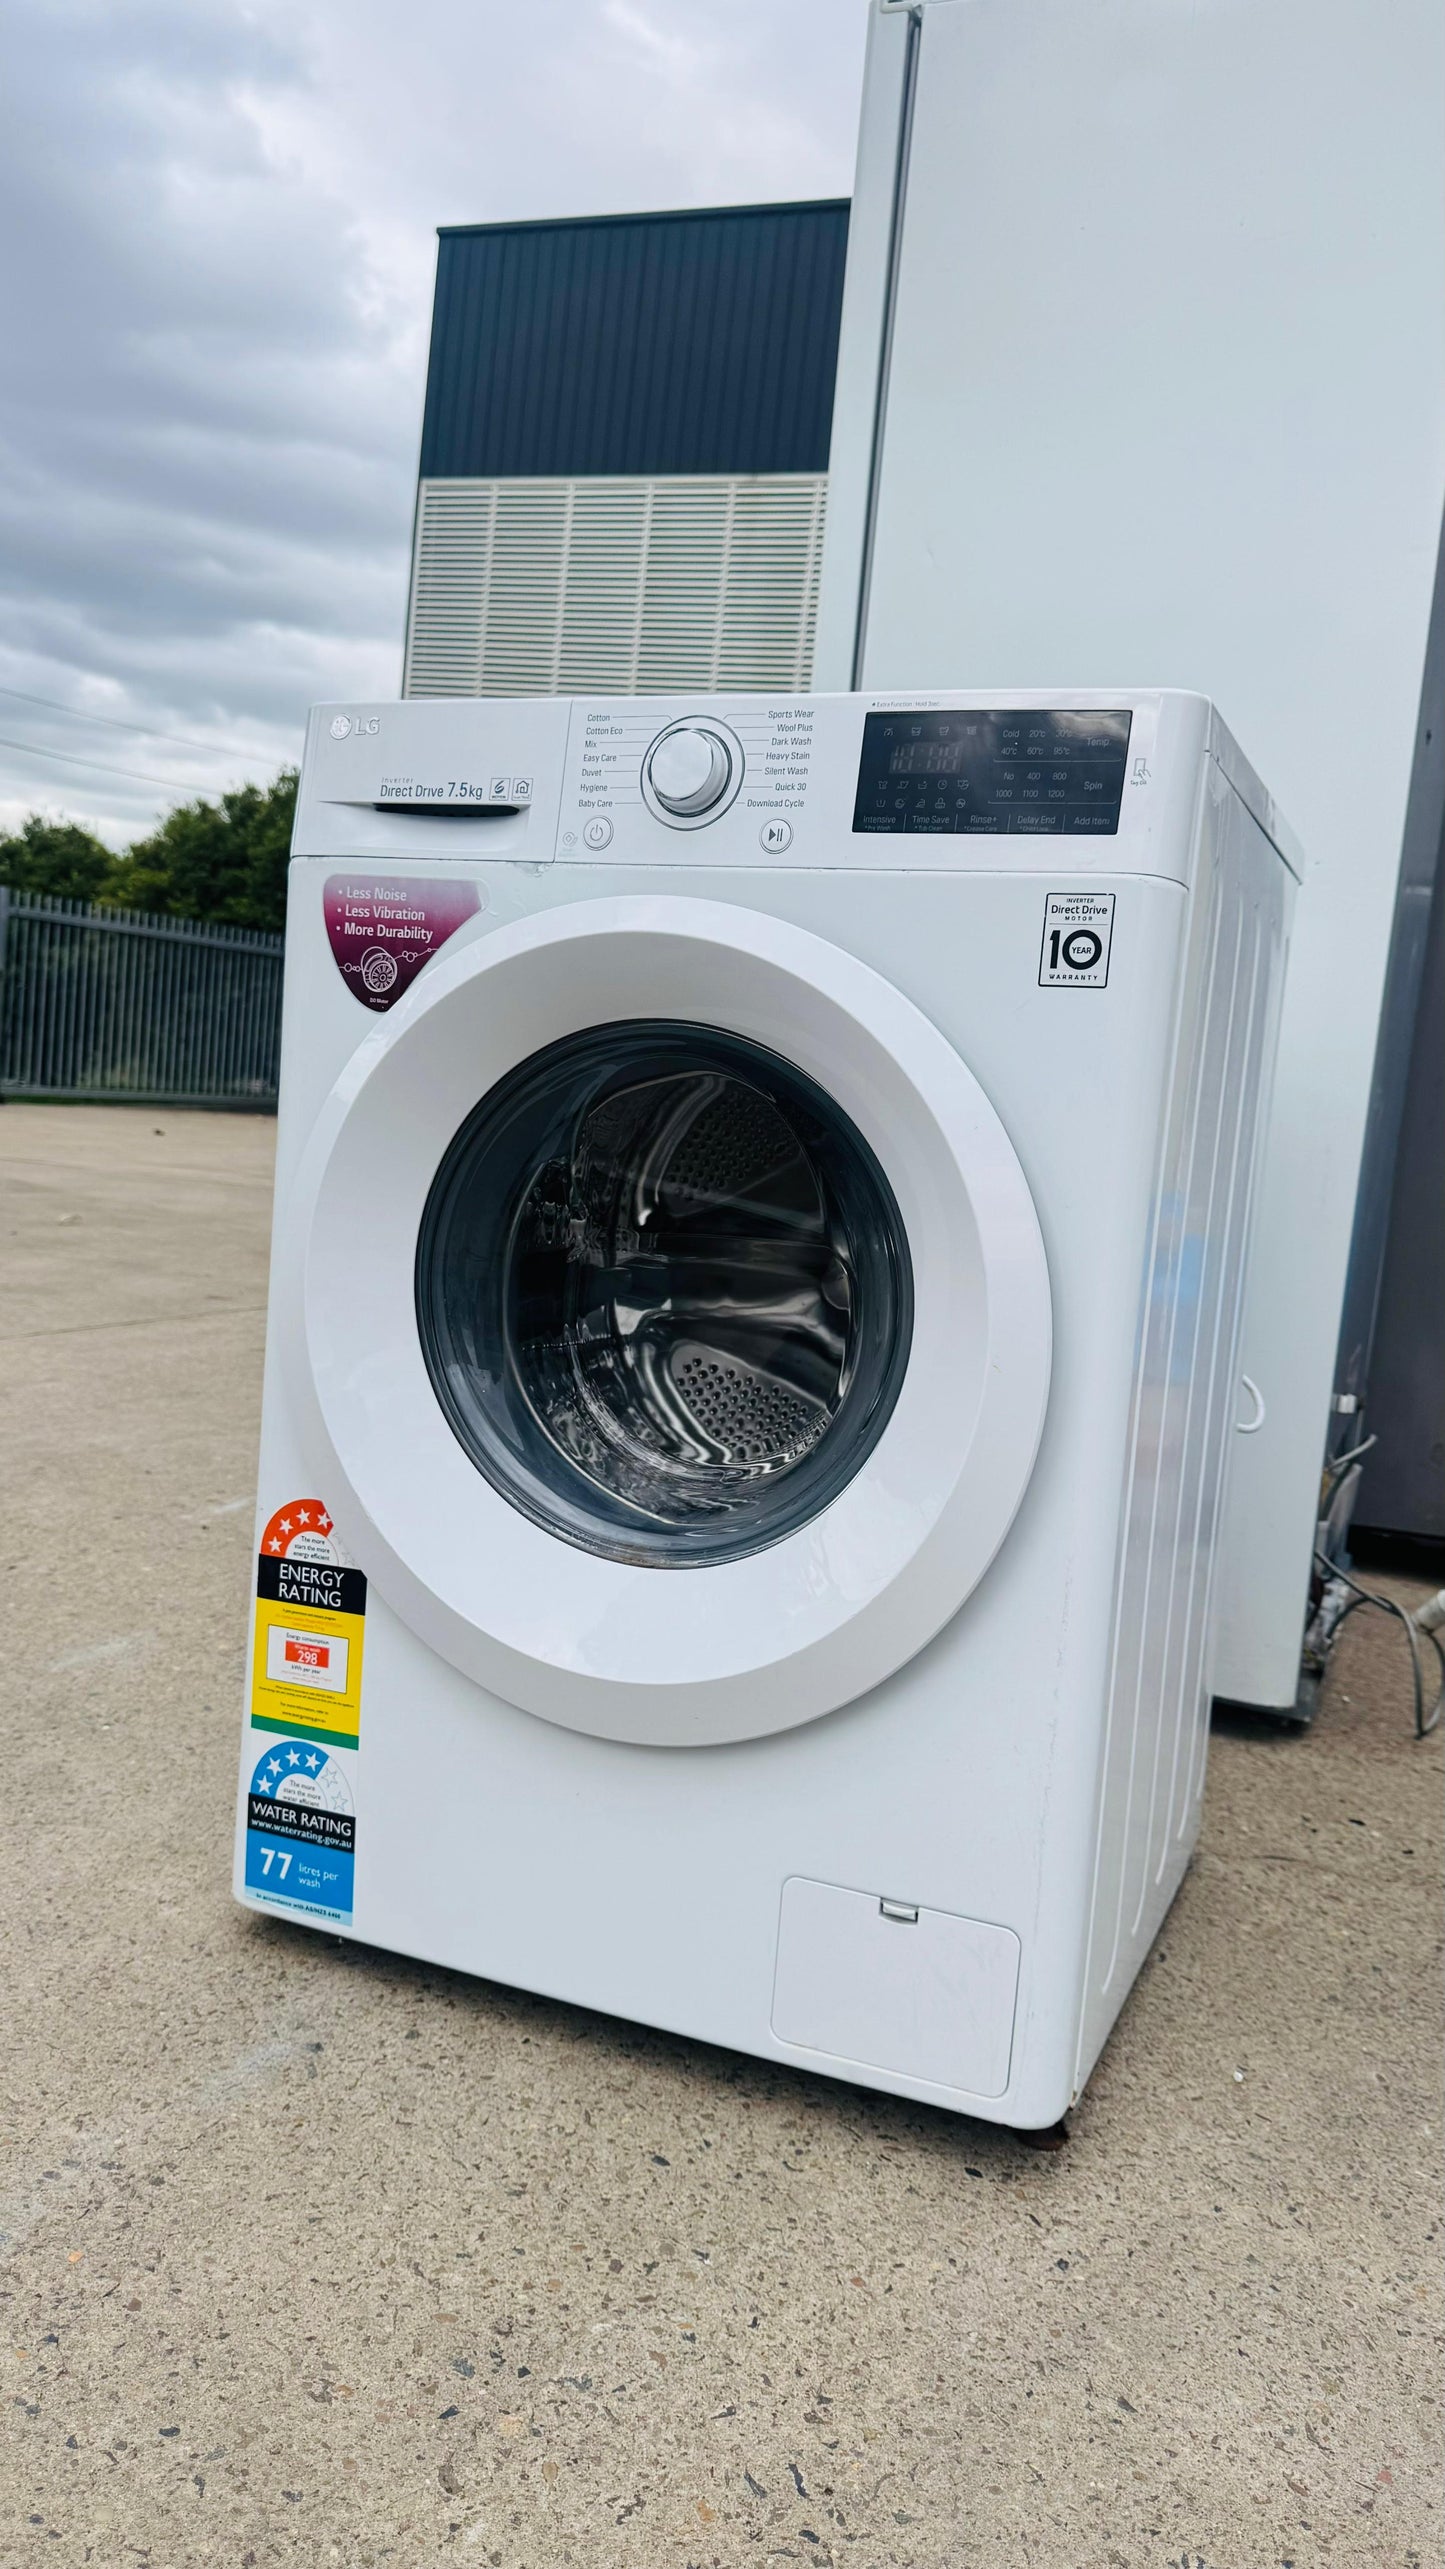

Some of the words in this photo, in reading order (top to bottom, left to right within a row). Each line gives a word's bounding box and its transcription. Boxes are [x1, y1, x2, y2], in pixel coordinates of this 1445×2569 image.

[587, 714, 611, 722] Cotton
[768, 710, 793, 720] Sports
[794, 710, 815, 718] Wear
[354, 716, 380, 736] LG
[777, 724, 796, 732] Wool
[797, 724, 813, 732] Plus
[586, 727, 609, 735] Cotton
[610, 727, 623, 735] Eco
[1002, 729, 1020, 738] Cold
[585, 740, 597, 748] Mix
[771, 738, 789, 746] Dark
[791, 737, 812, 745] Wash
[583, 754, 600, 763] Easy
[601, 754, 617, 762] Care
[766, 752, 790, 761] Heavy
[791, 752, 810, 760] Stain
[582, 768, 602, 777] Duvet
[764, 767, 785, 775] Silent
[787, 767, 809, 775] Wash
[1004, 772, 1015, 781] No
[1026, 772, 1041, 780] 400
[1052, 772, 1067, 780] 800
[380, 784, 413, 797] Direct
[416, 784, 444, 797] Drive
[448, 782, 483, 800] 7.5kg
[580, 784, 608, 793] Hygiene
[775, 782, 796, 791] Quick
[797, 782, 807, 791] 30
[1084, 781, 1103, 792] Spin
[996, 790, 1012, 798] 1000
[1023, 790, 1039, 798] 1100
[1048, 790, 1065, 798] 1200
[578, 799, 596, 808] Baby
[597, 800, 613, 808] Care
[747, 799, 783, 808] Download
[784, 799, 805, 808] Cycle
[864, 816, 896, 824] Intensive
[913, 815, 930, 824] Time
[931, 815, 950, 824] Save
[970, 815, 997, 824] Rinse+
[1017, 816, 1039, 824] Delay
[1040, 816, 1056, 824] End
[1074, 817, 1090, 825] Add
[1091, 817, 1110, 825] Item
[346, 886, 372, 899] Less
[374, 887, 407, 901] Noise
[345, 904, 370, 918] Less
[373, 905, 425, 921] Vibration
[1051, 905, 1080, 914] Direct
[1082, 905, 1108, 914] Drive
[344, 922, 374, 936] More
[377, 924, 433, 943] Durability
[1050, 929, 1102, 970] 10
[1072, 946, 1092, 954] YEAR
[310, 1553, 330, 1561] efficient
[279, 1563, 345, 1588] ENERGY
[279, 1582, 342, 1608] RATING
[297, 1650, 318, 1665] 298
[290, 1780, 300, 1788] The
[252, 1801, 297, 1824] WATER
[300, 1812, 352, 1836] RATING
[251, 1819, 352, 1848] www.waterrating.gov.au
[260, 1847, 293, 1880] 77
[298, 1863, 321, 1877] litres
[323, 1871, 339, 1881] per
[298, 1876, 321, 1888] wash
